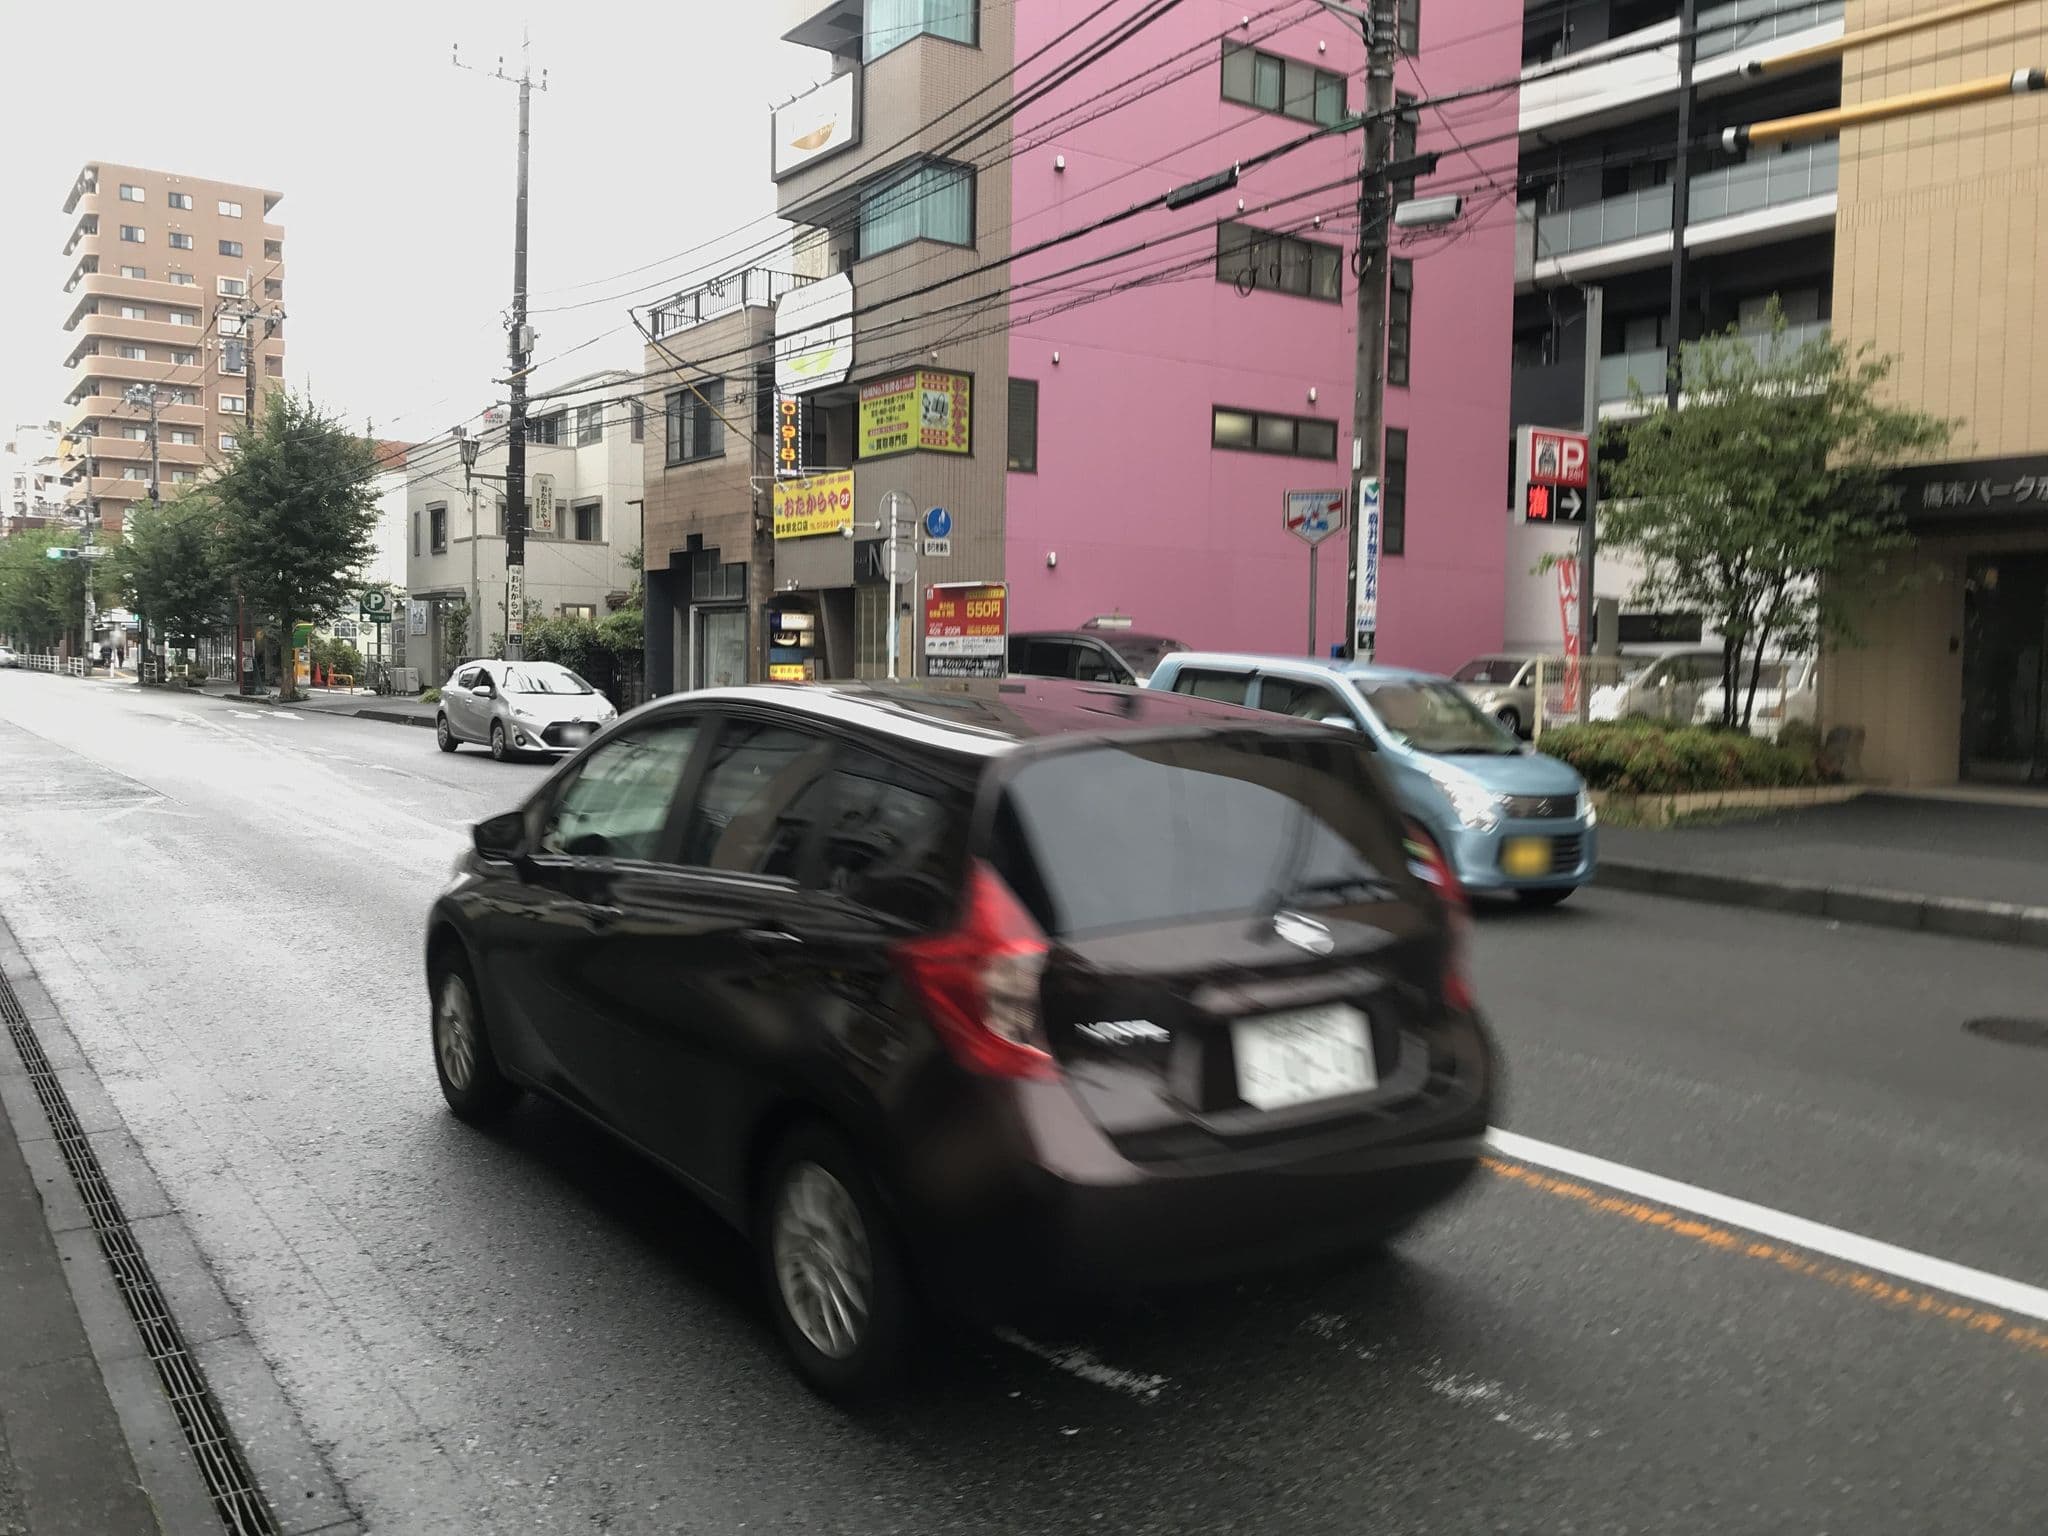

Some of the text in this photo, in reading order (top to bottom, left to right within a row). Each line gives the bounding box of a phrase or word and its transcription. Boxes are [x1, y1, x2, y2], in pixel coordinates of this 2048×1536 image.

[1562, 440, 1584, 480] P
[784, 490, 850, 520] おたからや 2F
